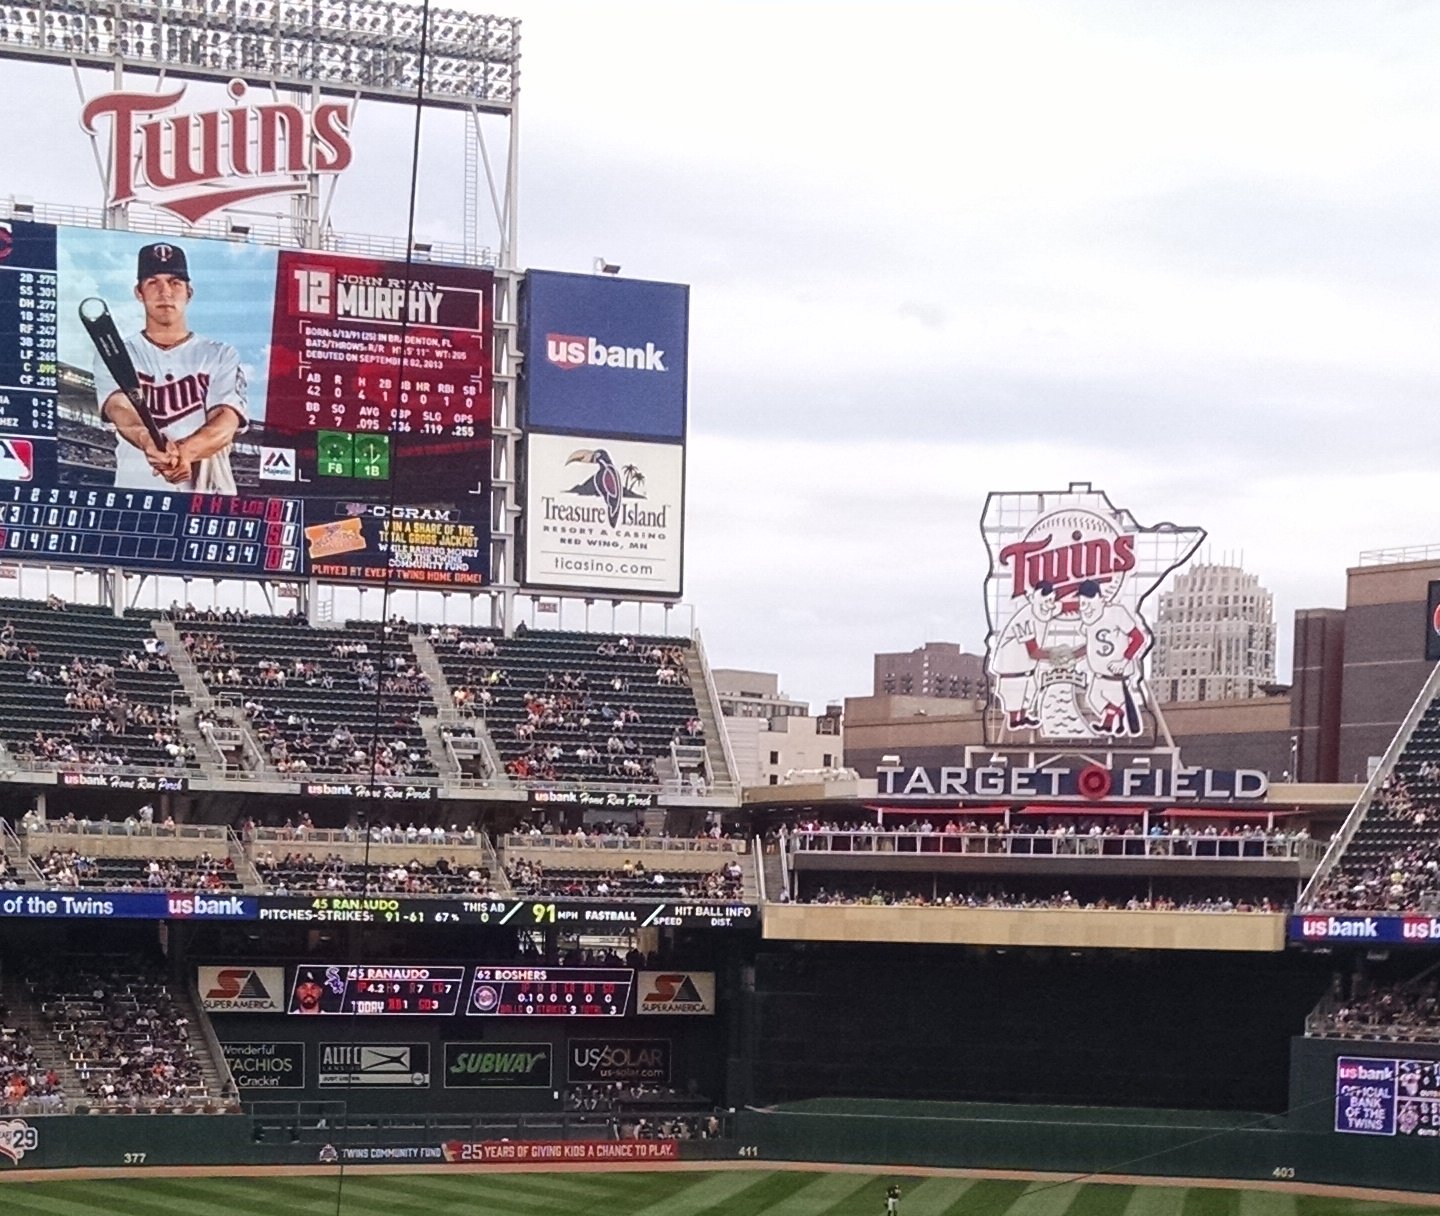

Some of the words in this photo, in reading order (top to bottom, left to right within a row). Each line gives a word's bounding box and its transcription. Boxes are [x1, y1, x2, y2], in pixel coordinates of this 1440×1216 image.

[81, 78, 352, 207] Twins
[337, 274, 383, 286] JOHN
[388, 278, 435, 291] RYAN
[294, 269, 331, 314] 12
[337, 283, 444, 323] MURPHY
[541, 497, 606, 524] Treasure
[622, 503, 667, 527] Island
[543, 525, 595, 536] RESORT
[616, 530, 666, 540] CASINO
[560, 537, 581, 546] RED
[587, 539, 623, 550] WING,
[629, 542, 648, 550] MN
[555, 557, 653, 575] ticasino.com
[1000, 530, 1136, 599] Twins
[877, 766, 1070, 796] TARGET
[1123, 768, 1269, 799] FIELD
[4, 896, 24, 913] of
[27, 896, 57, 914] the
[62, 896, 114, 915] Twins
[312, 899, 329, 910] 45
[333, 899, 399, 911] RANAUDO
[463, 902, 488, 912] THIS
[490, 902, 506, 913] AB
[675, 906, 693, 916] HIT
[695, 907, 723, 917] BALL
[726, 907, 752, 918] INFO
[260, 910, 374, 921] PITCHES-STRIKES:
[532, 904, 555, 923] 91
[558, 911, 579, 920] MPH
[585, 911, 637, 921] FASTBALL
[653, 917, 683, 926] SPEED
[711, 918, 733, 927] DIST.
[348, 969, 365, 980] 45
[367, 969, 430, 980] RANAUDO
[477, 970, 491, 980] 62
[494, 970, 548, 981] BOSHERS
[450, 1052, 546, 1074] SUBWAY
[12, 1129, 37, 1148] 29
[123, 1153, 147, 1163] 377
[343, 1148, 369, 1158] TWINS
[371, 1148, 418, 1159] COMMUNITY
[420, 1147, 441, 1158] FUND
[461, 1144, 482, 1159] 25
[484, 1145, 515, 1158] YEARS
[517, 1145, 528, 1157] OF
[531, 1145, 561, 1157] GIVING
[564, 1144, 586, 1157] KIDS
[587, 1144, 595, 1157] A
[596, 1144, 634, 1157] CHANCE
[636, 1144, 647, 1157] TO
[649, 1144, 673, 1157] PLAY.
[739, 1146, 758, 1157] 411
[1272, 1168, 1296, 1178] 403
